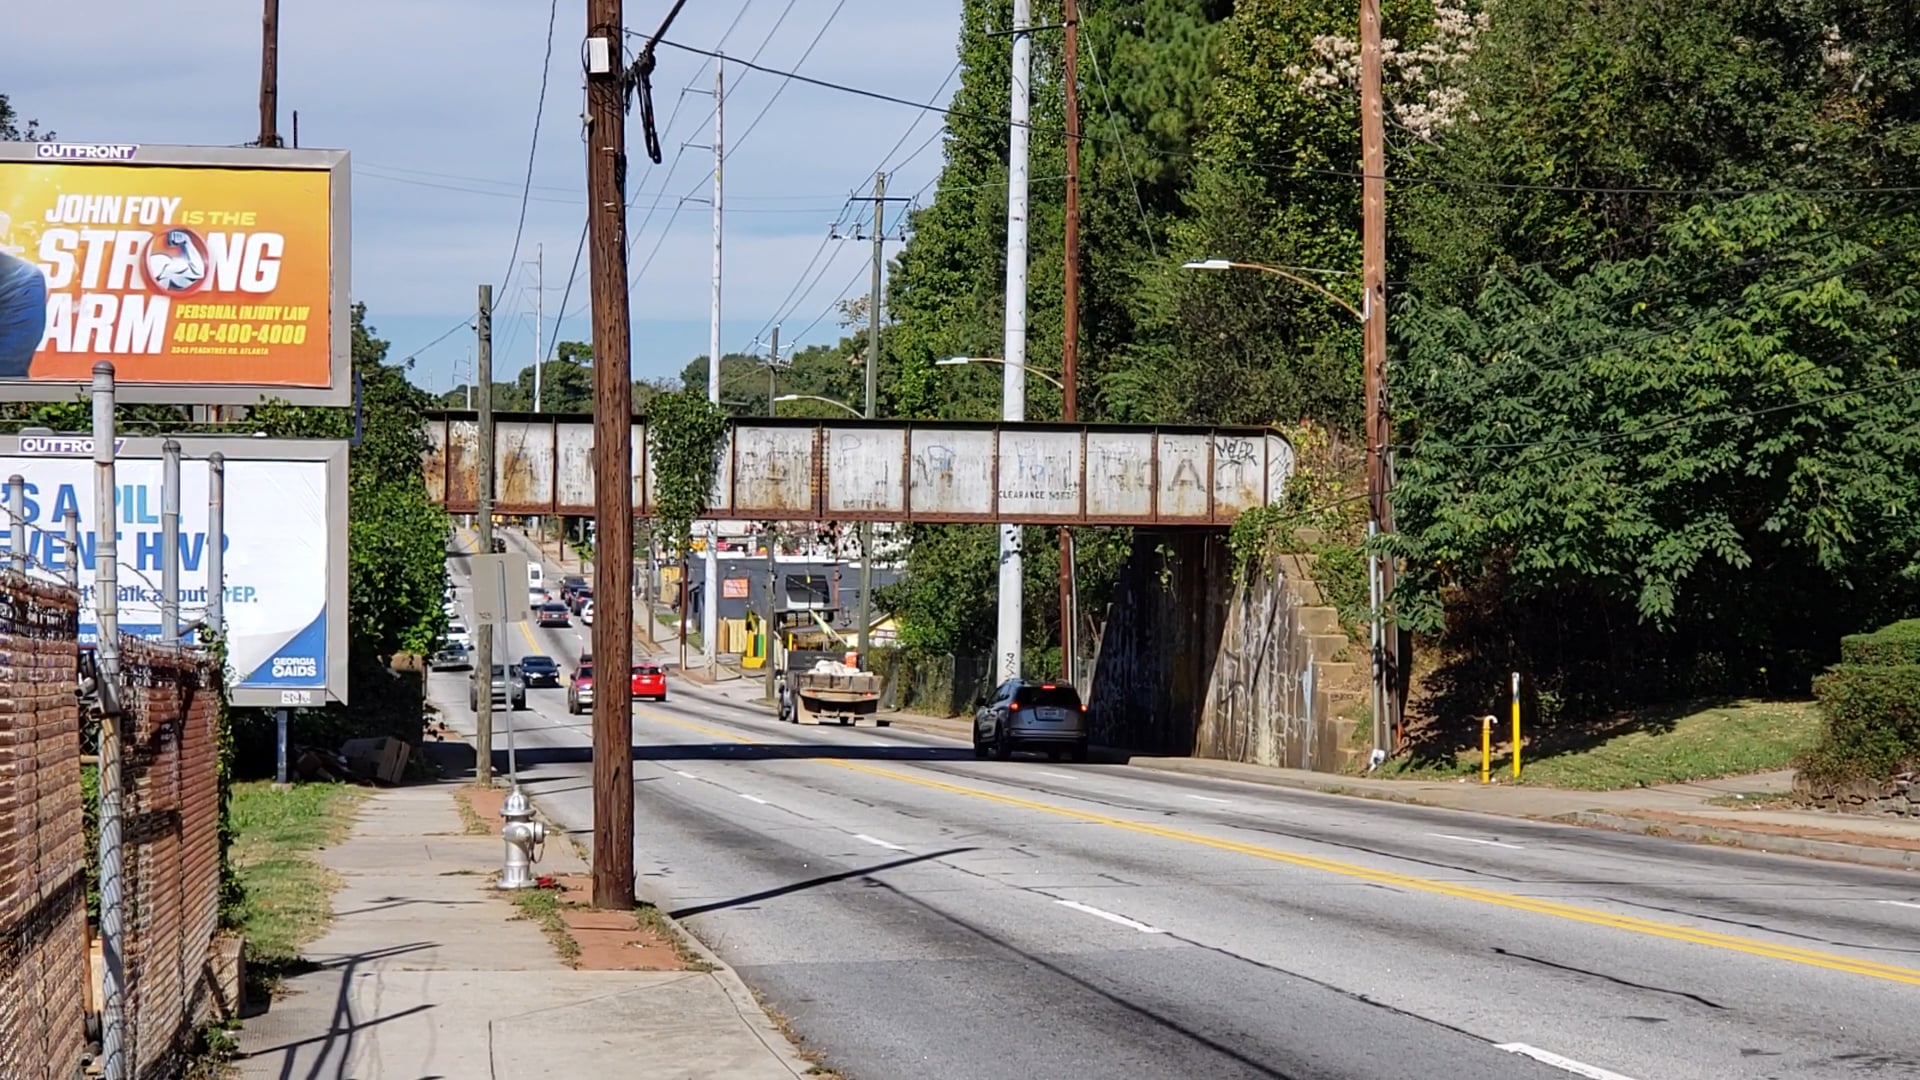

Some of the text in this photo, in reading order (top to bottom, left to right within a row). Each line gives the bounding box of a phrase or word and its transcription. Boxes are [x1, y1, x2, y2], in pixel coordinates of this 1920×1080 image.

[39, 145, 133, 160] OUTFRONT
[45, 194, 257, 226] JOHN FOY IS THE
[175, 304, 310, 321] PERSONAL INJURY LAW
[36, 293, 171, 355] ARM
[173, 322, 306, 345] 404-400-4000
[22, 438, 119, 453] OUTFRO
[998, 490, 1046, 500] CLEARANCE
[51, 484, 82, 523] A
[114, 485, 183, 524] IL
[222, 586, 258, 603] rEP.
[273, 657, 316, 667] GEORGIA
